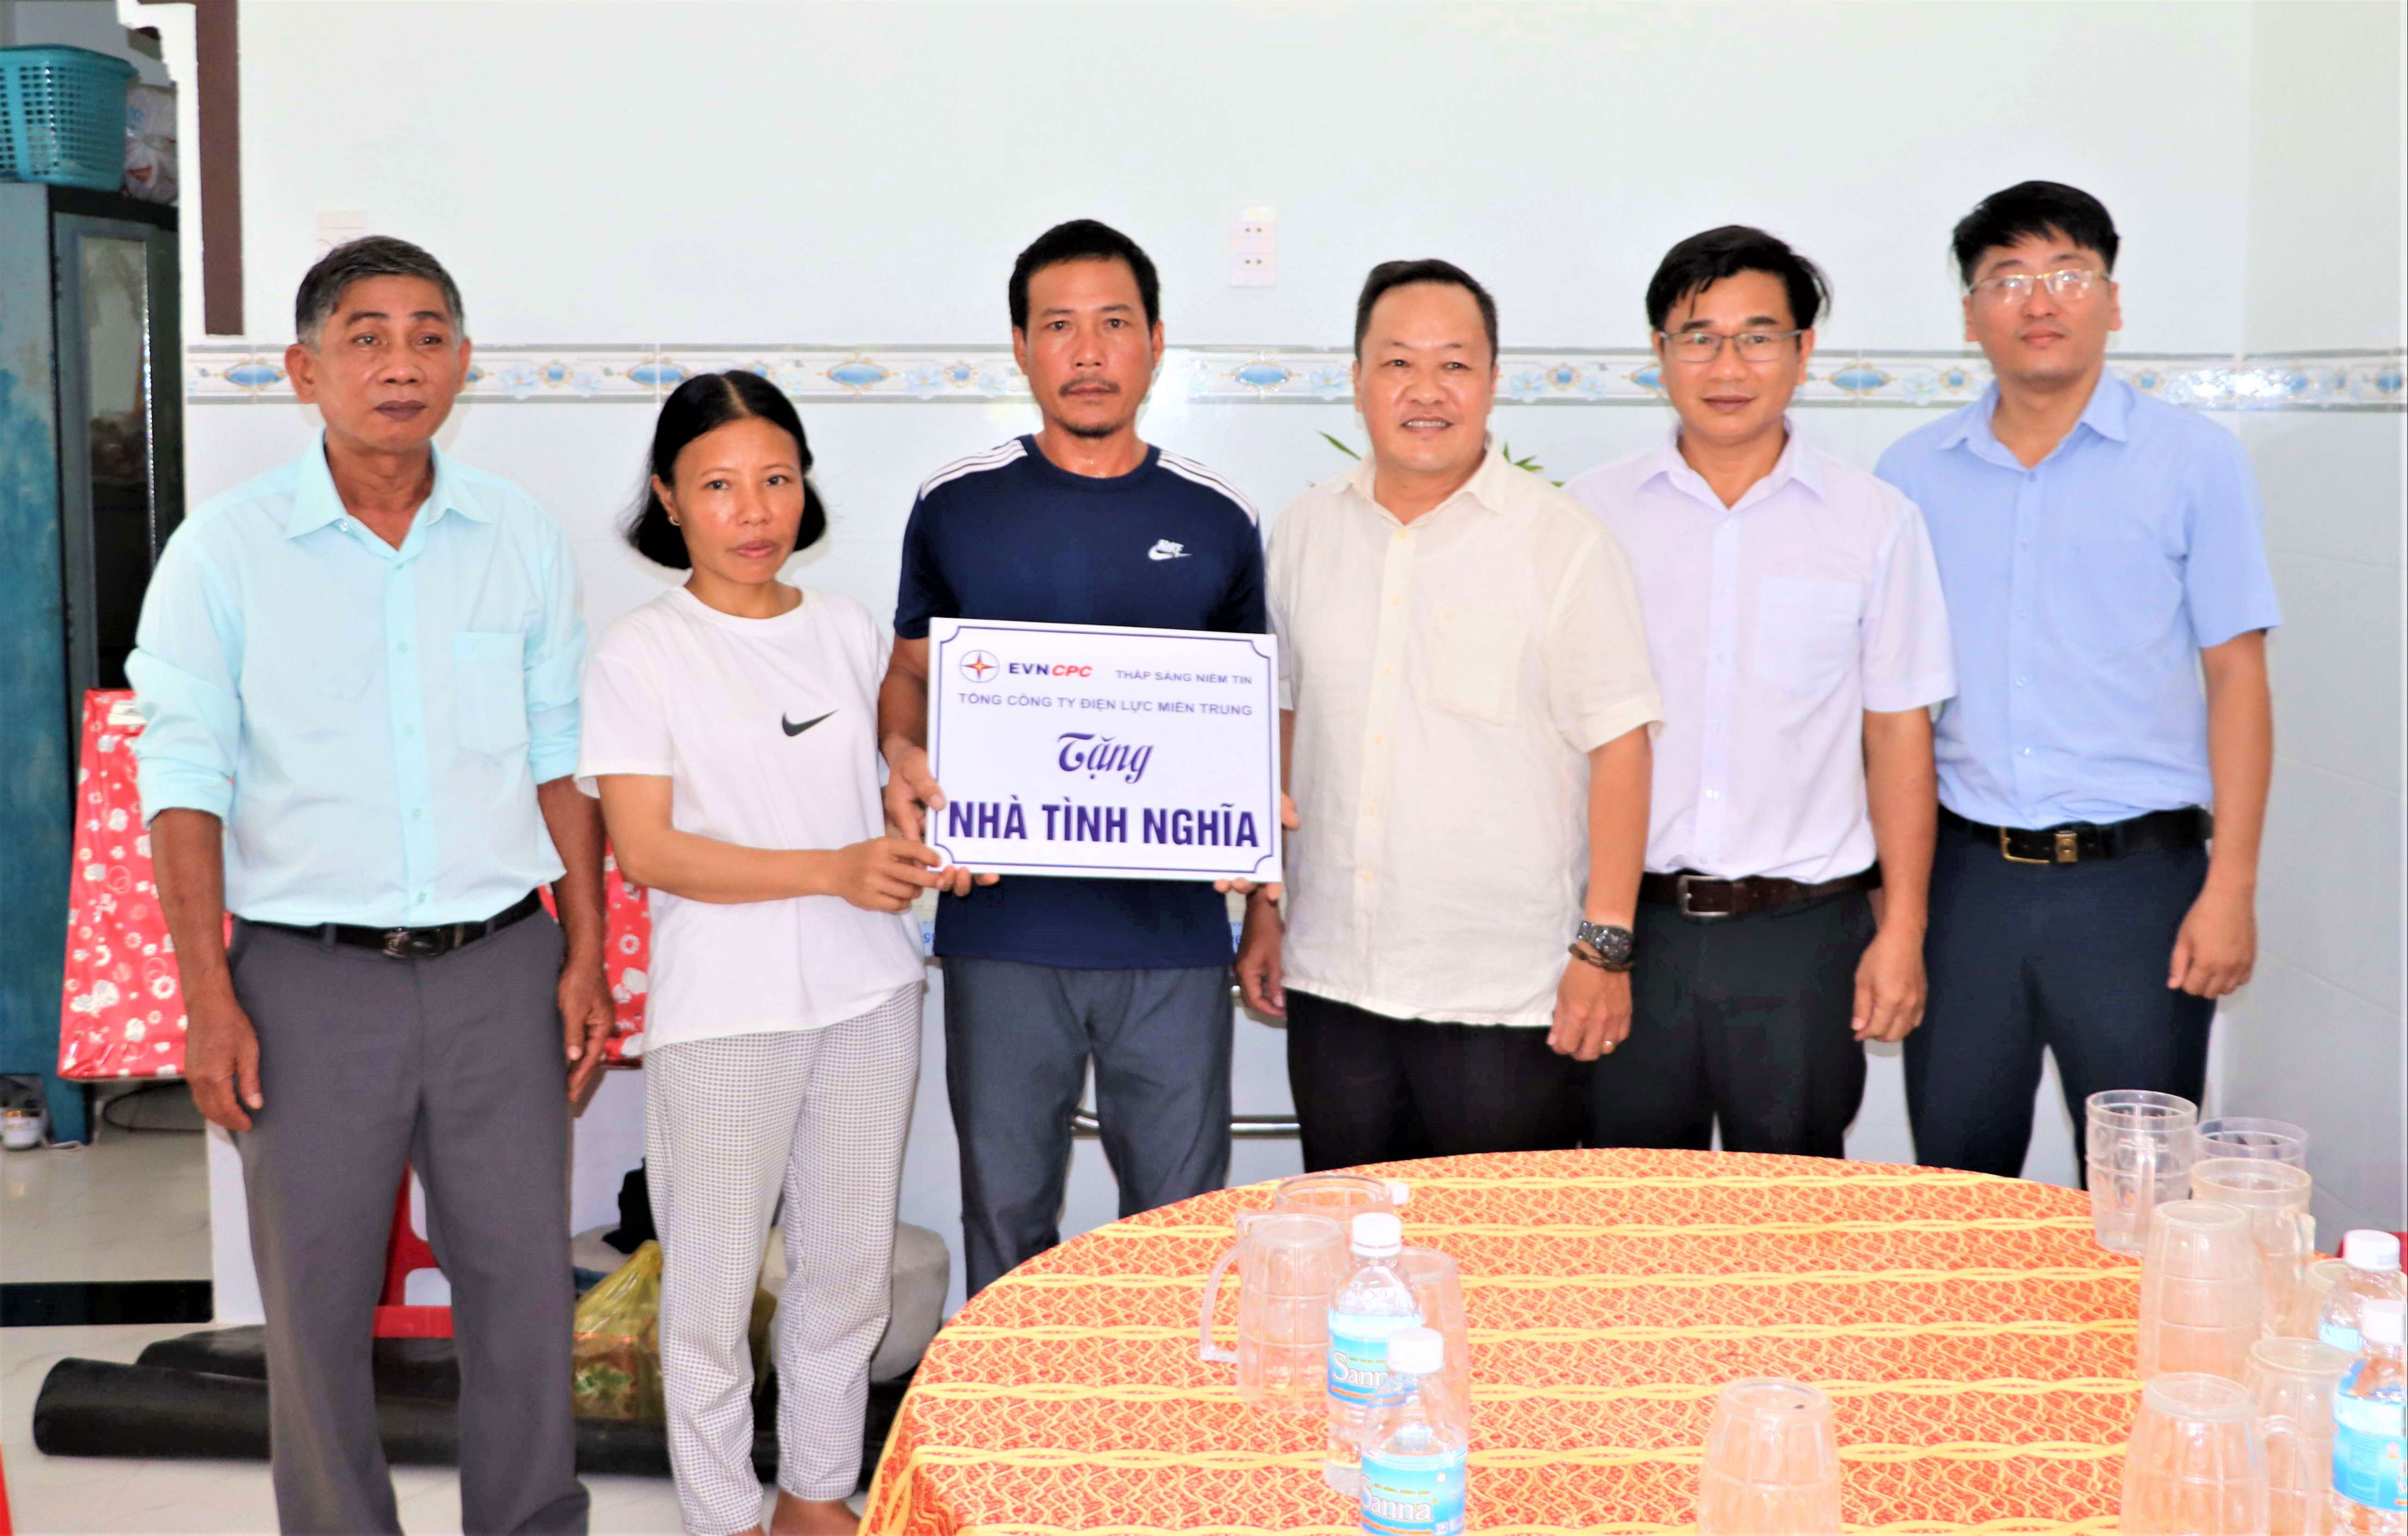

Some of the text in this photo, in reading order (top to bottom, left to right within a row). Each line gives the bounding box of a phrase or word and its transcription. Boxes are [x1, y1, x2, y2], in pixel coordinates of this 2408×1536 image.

[1232, 675, 1253, 685] TIN
[1007, 693, 1053, 707] CÔNG
[1057, 697, 1076, 708] TY
[1121, 699, 1153, 714] LỰC
[1199, 703, 1253, 716] TRUNG
[1057, 731, 1155, 784] Tặng
[949, 794, 1259, 848] NHÀ TÌNH NGHĨA
[1333, 1351, 1388, 1387] Sann
